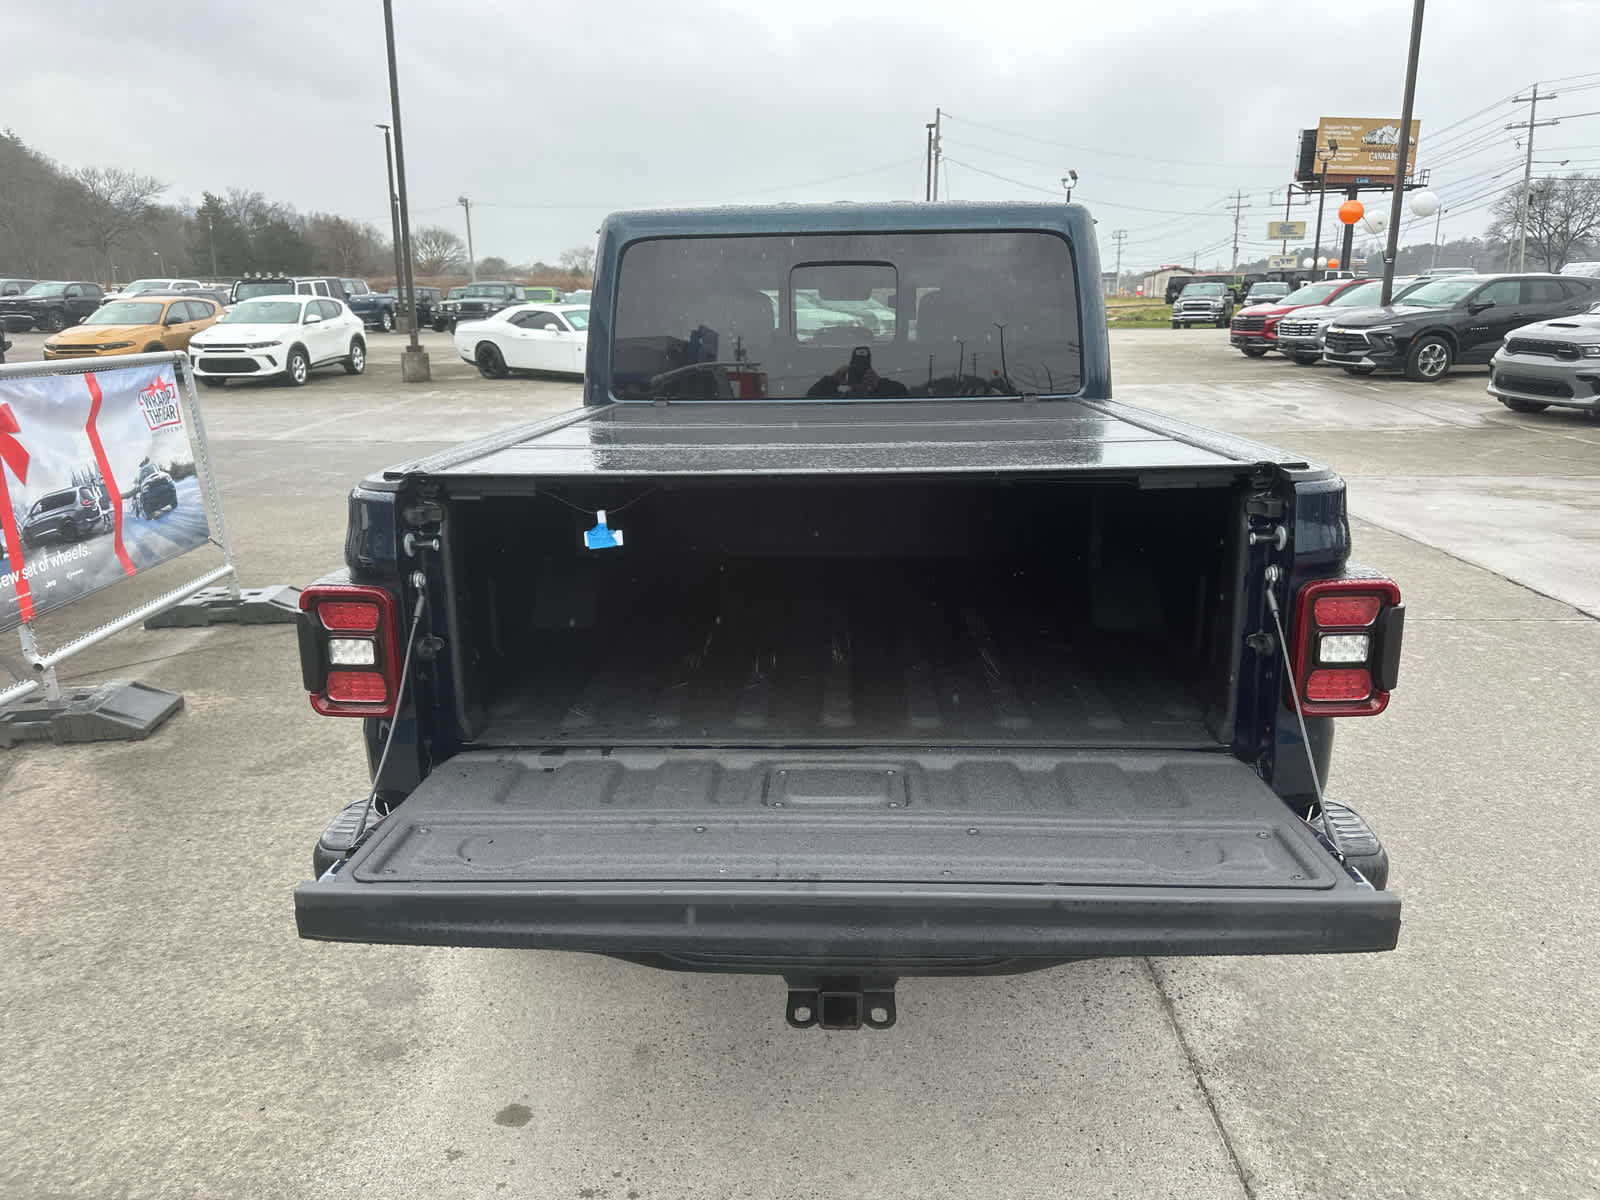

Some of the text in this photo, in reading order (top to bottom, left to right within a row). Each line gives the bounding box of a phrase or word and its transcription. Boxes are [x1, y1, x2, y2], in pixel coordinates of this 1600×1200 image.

[0, 570, 20, 589] ew
[22, 561, 38, 580] set
[50, 543, 92, 567] wheels.
